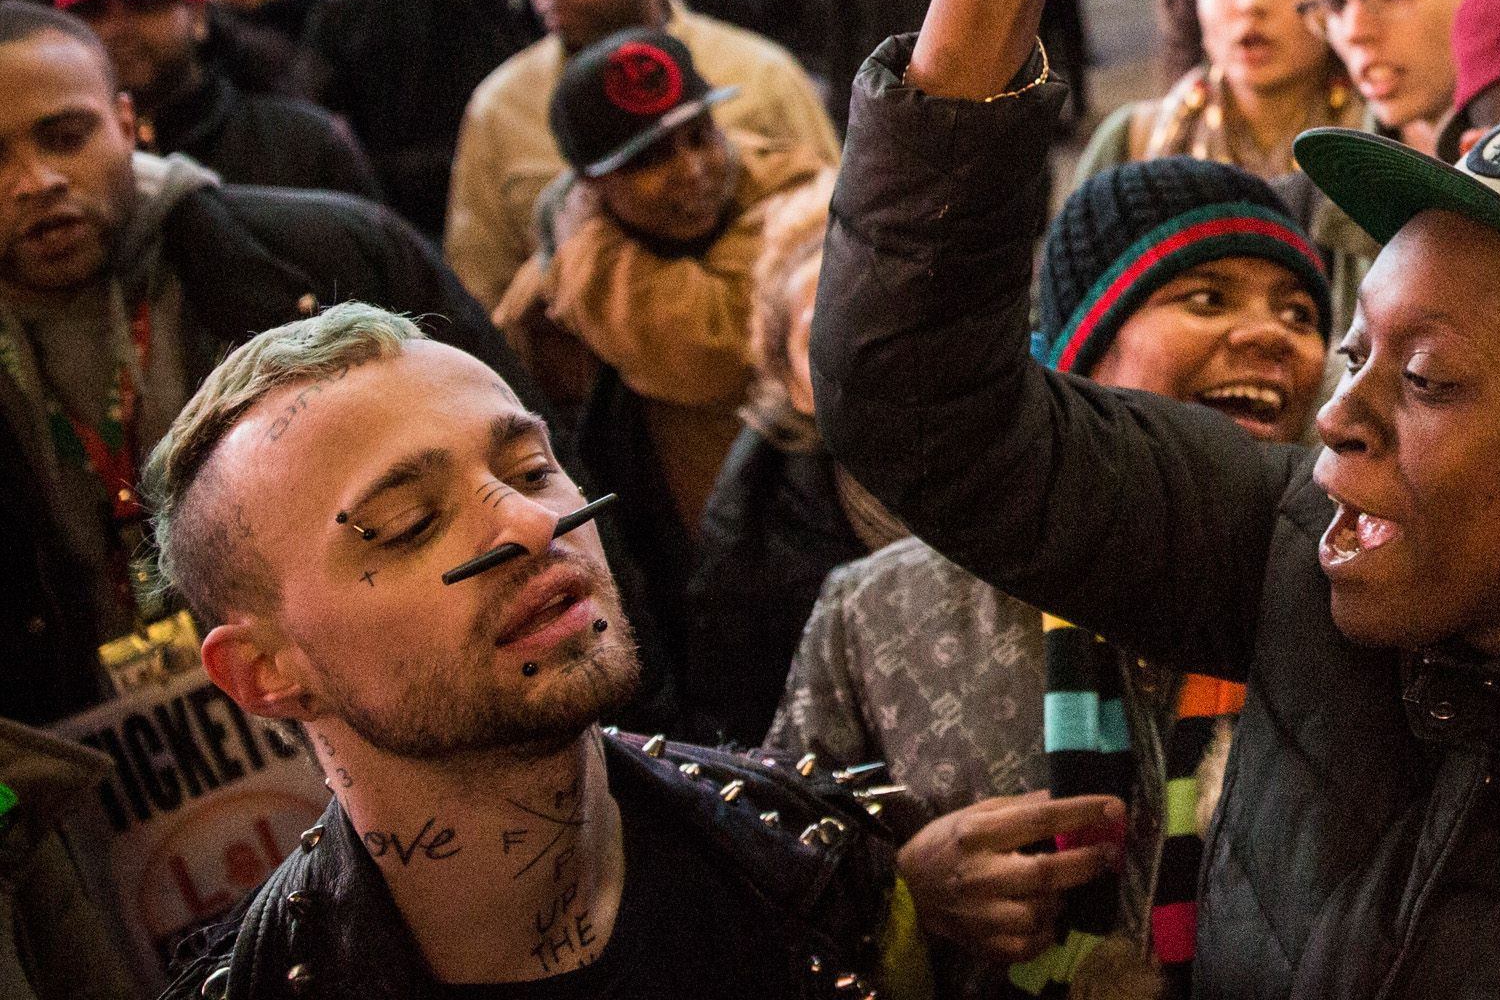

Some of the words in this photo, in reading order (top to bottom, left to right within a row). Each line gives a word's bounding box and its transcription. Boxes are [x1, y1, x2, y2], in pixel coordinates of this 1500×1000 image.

[80, 684, 298, 833] TICKET
[364, 817, 463, 866] ove
[530, 910, 596, 972] THE
